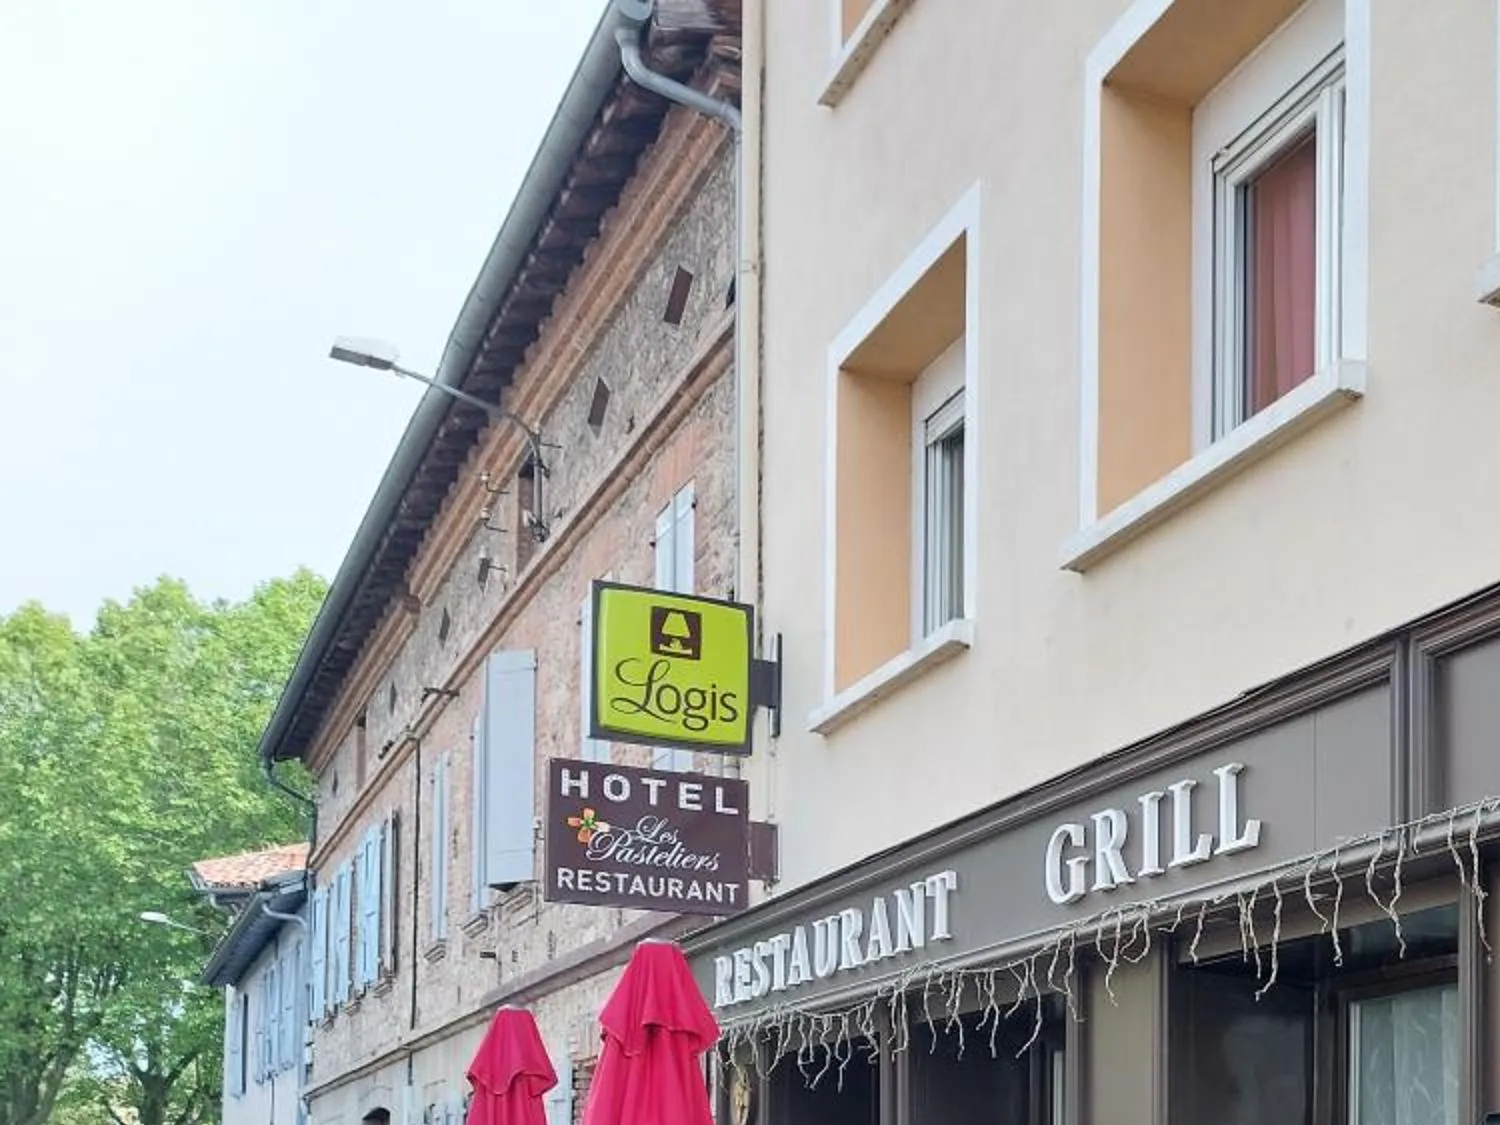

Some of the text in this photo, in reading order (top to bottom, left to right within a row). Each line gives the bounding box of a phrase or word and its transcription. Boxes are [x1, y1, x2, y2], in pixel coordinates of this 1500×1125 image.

[610, 657, 738, 731] Logis
[561, 768, 739, 815] HOTEL
[586, 826, 720, 872] Pasteliers
[635, 815, 679, 845] Les
[557, 867, 740, 904] RESTAURANT
[714, 762, 1262, 1008] RESTAURANT GRILL
